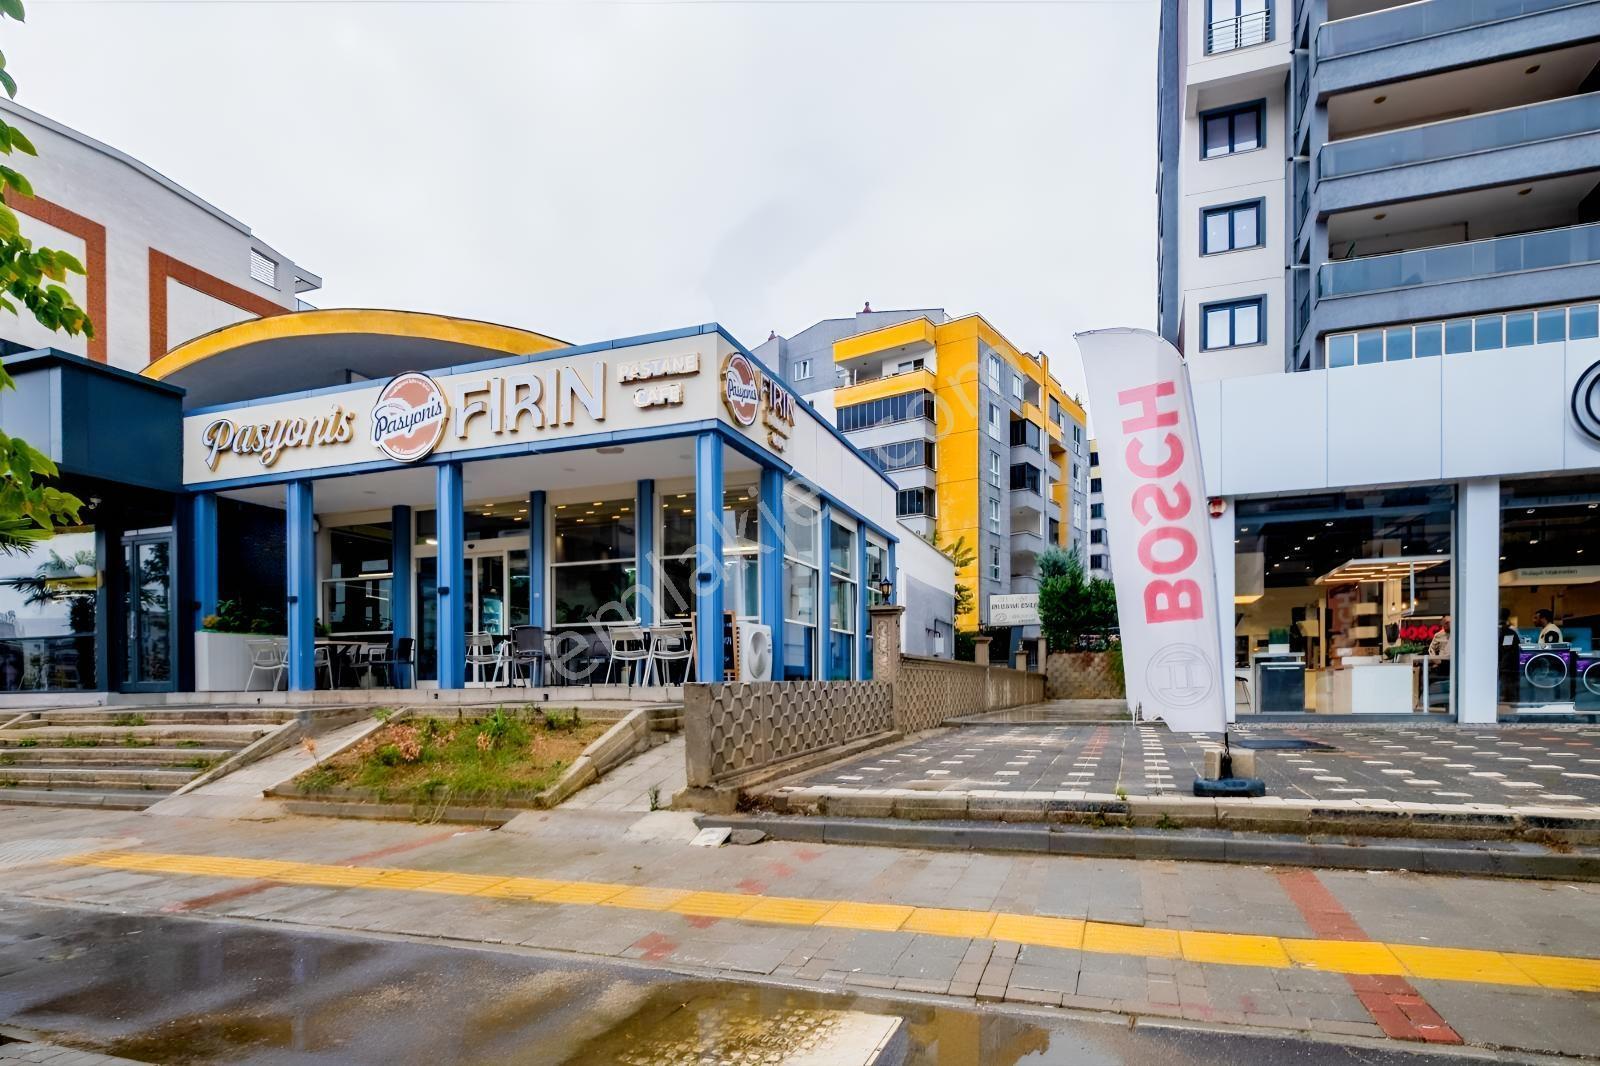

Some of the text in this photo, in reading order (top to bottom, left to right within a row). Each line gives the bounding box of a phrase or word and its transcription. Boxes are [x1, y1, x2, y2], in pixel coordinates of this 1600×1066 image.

[617, 352, 700, 384] PASTANE
[374, 397, 443, 442] Pasyonis
[455, 361, 607, 439] FIRIN
[202, 403, 355, 472] Pasyonis
[1399, 623, 1443, 641] OSC
